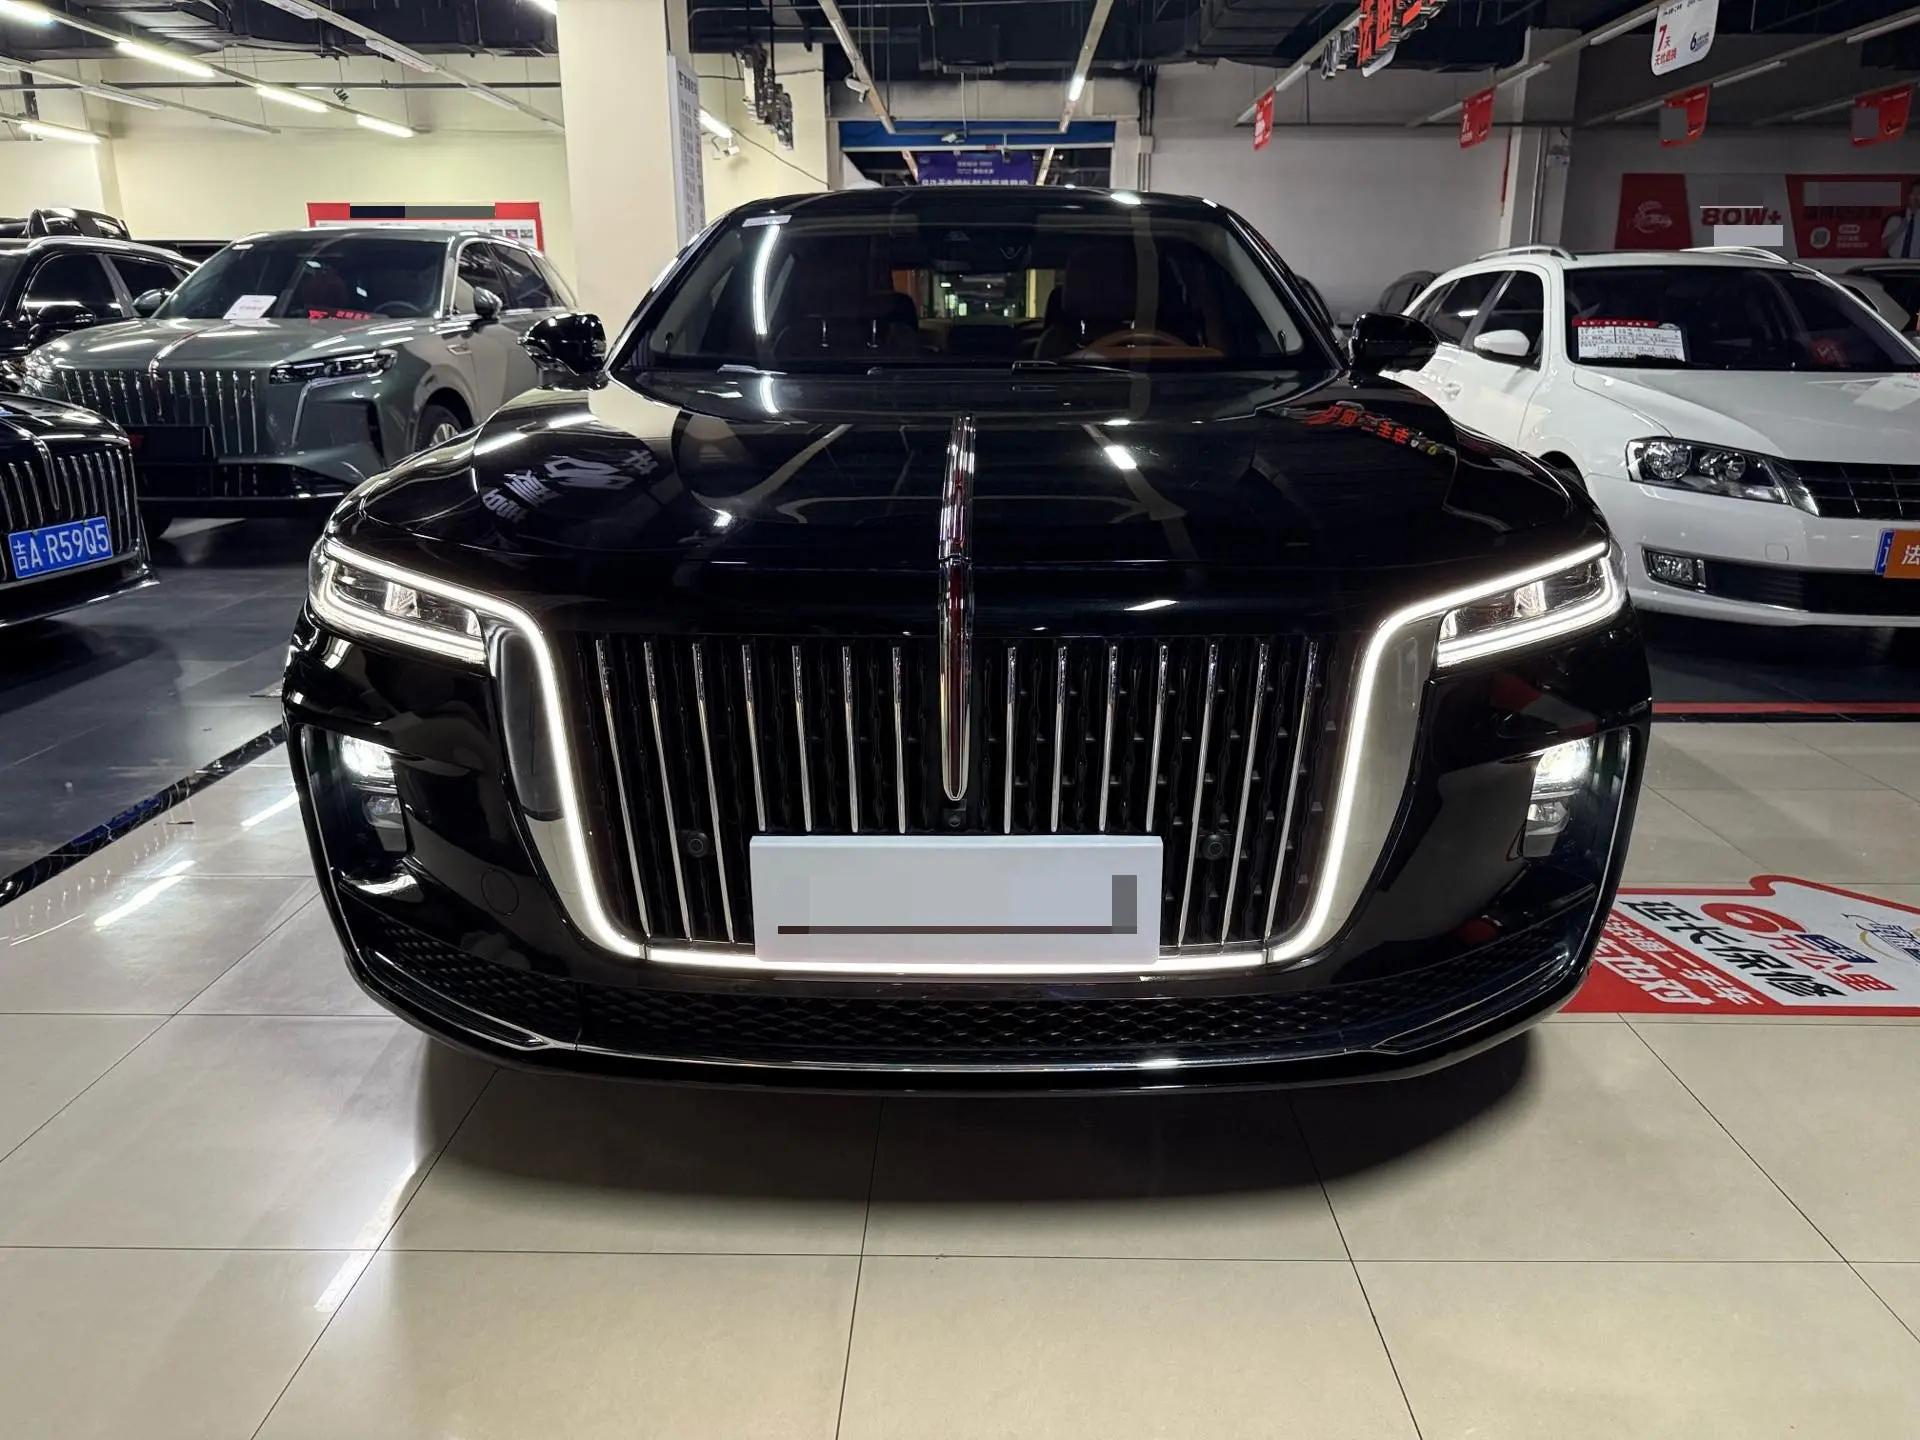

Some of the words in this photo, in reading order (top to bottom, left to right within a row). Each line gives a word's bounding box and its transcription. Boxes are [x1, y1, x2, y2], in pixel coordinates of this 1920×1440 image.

[1620, 901, 1848, 998] 延长保修
[1700, 902, 1897, 992] 6万公里
